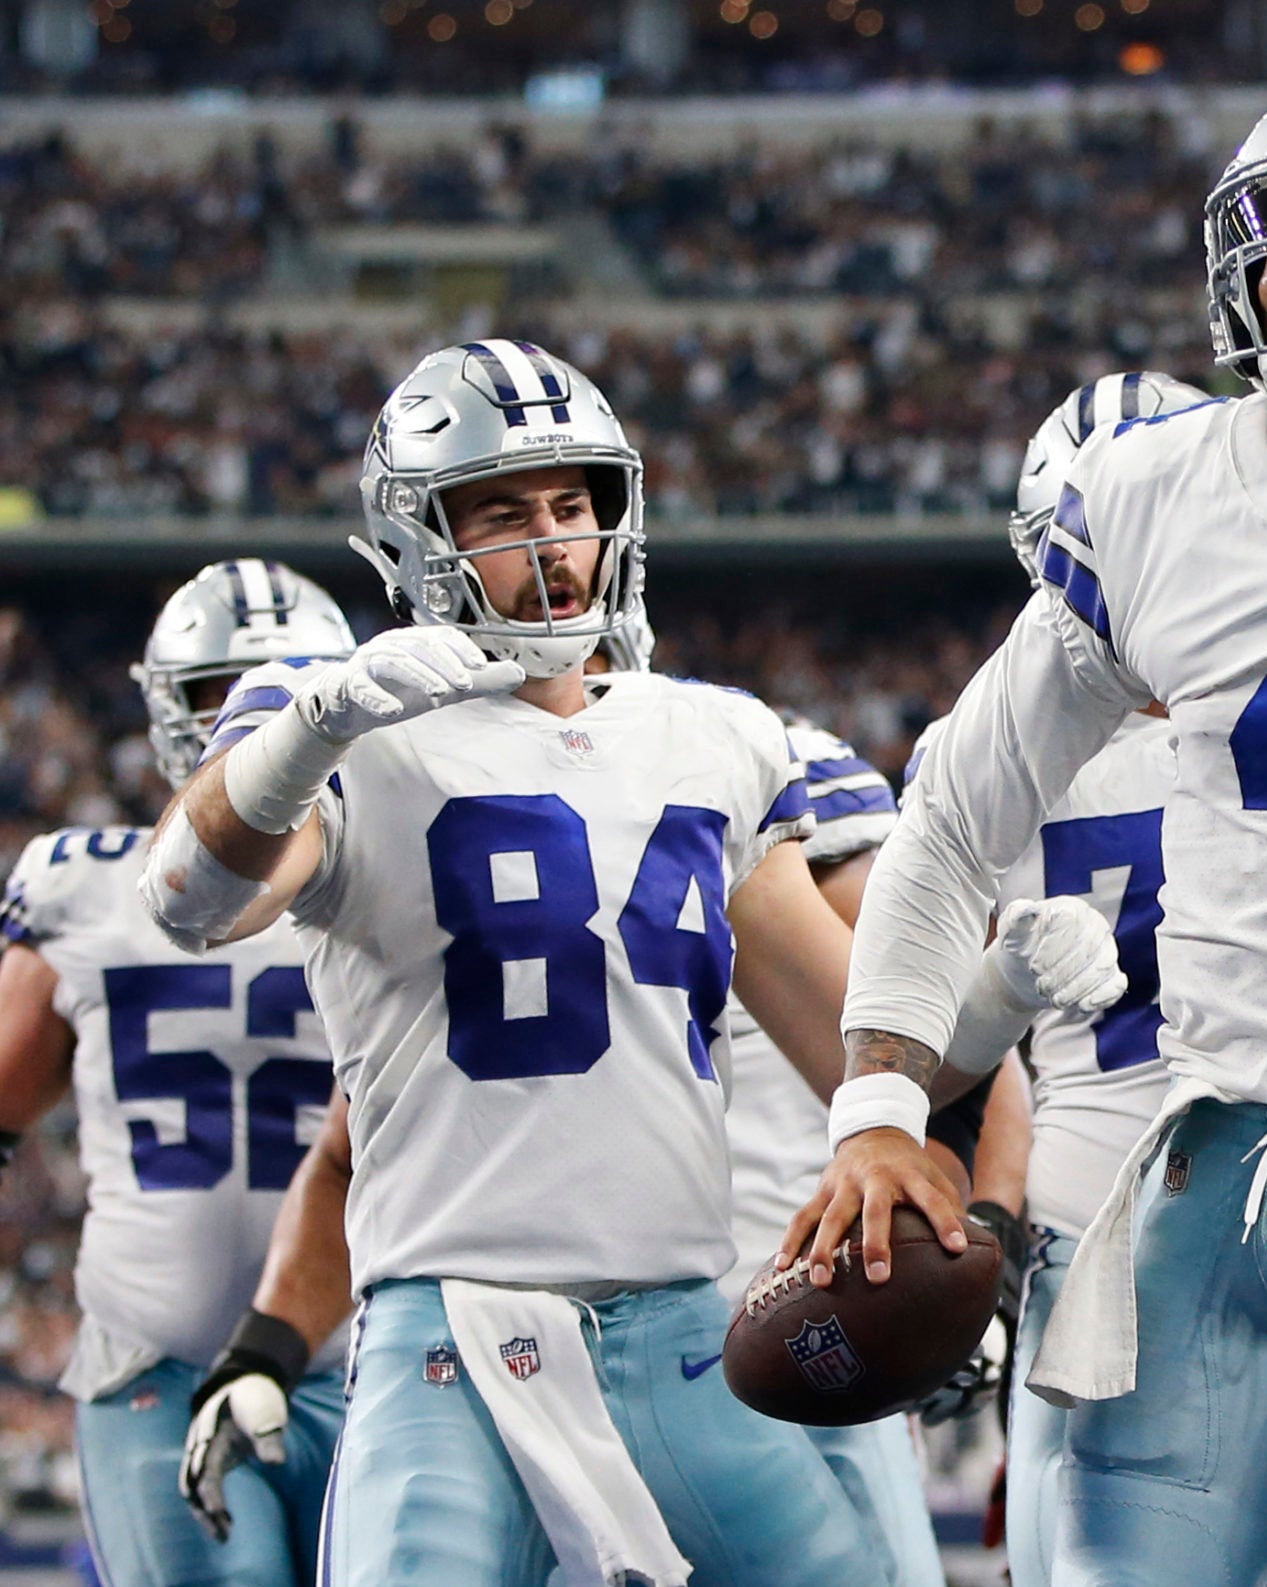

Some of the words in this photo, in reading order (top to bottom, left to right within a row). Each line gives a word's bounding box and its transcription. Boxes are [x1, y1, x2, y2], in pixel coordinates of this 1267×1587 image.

[426, 793, 736, 1082] 84
[103, 964, 347, 1191] 52
[427, 1363, 455, 1380] NFL
[504, 1354, 538, 1379] NFL
[801, 1346, 860, 1389] NFL
